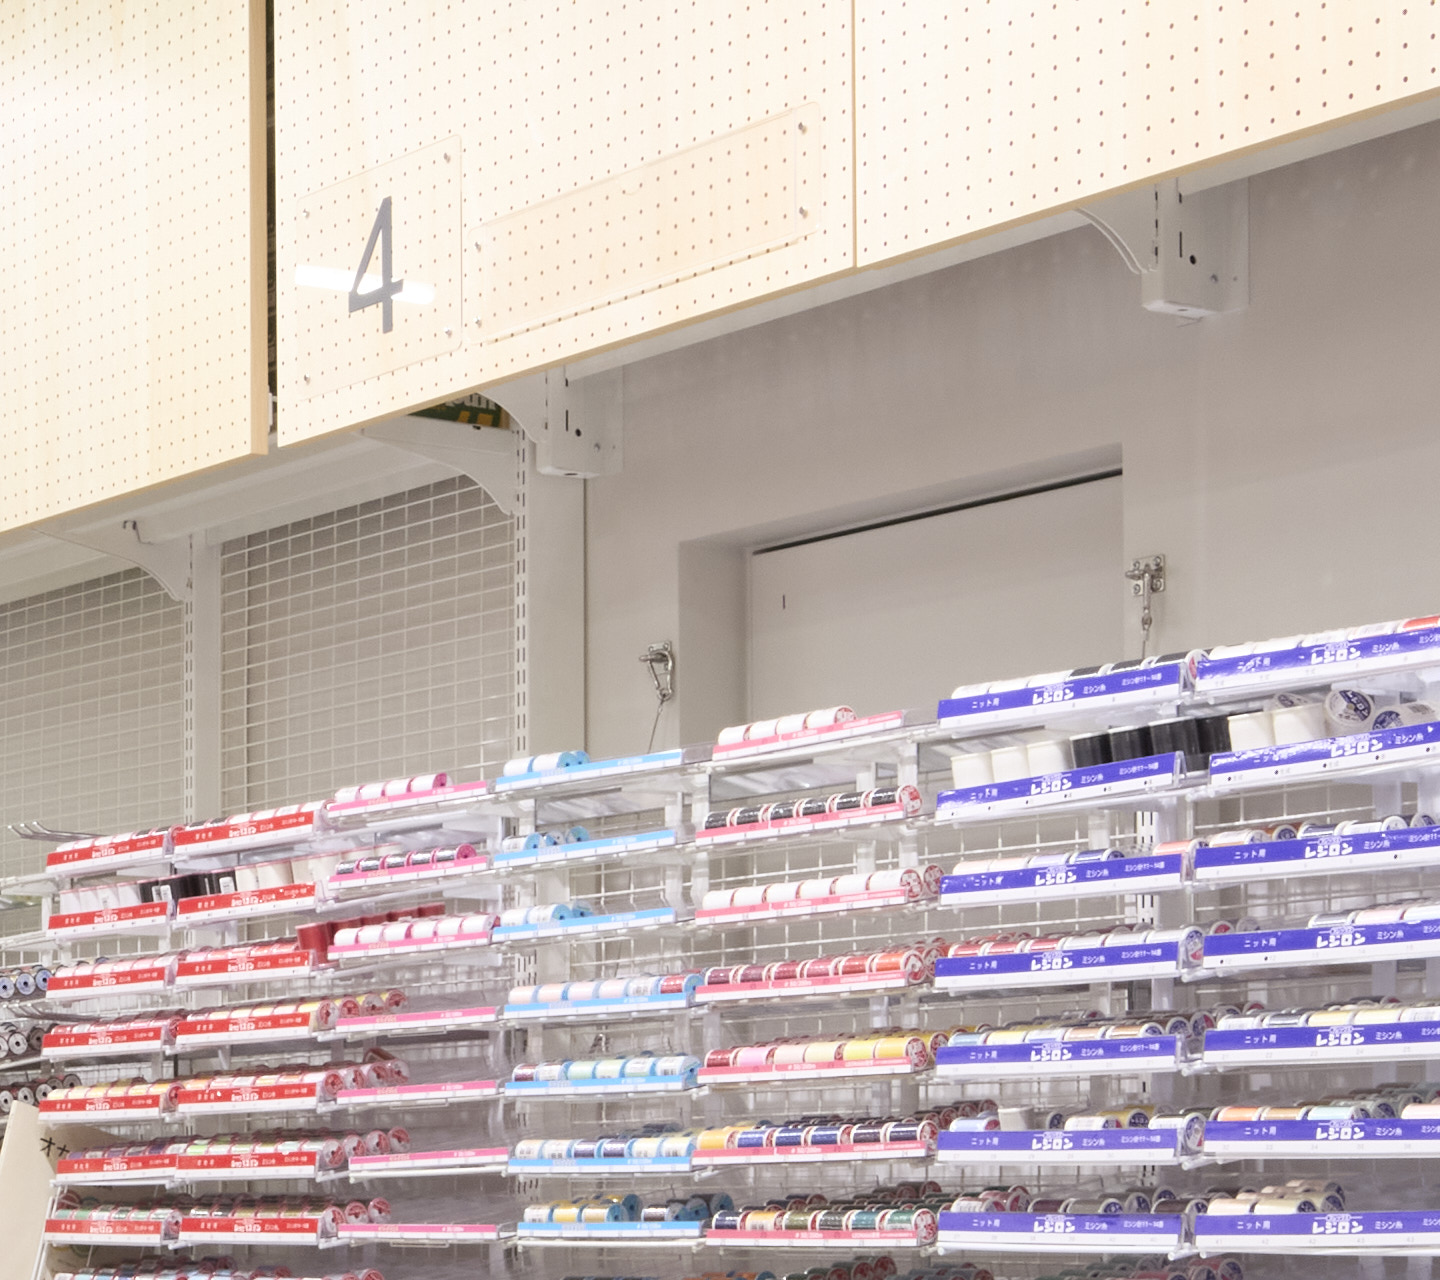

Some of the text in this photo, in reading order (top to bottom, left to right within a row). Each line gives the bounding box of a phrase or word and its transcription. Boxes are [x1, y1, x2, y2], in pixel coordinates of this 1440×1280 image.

[344, 190, 408, 336] 4
[1244, 1032, 1277, 1045] ニット用
[1376, 1031, 1402, 1040] ミシン糸
